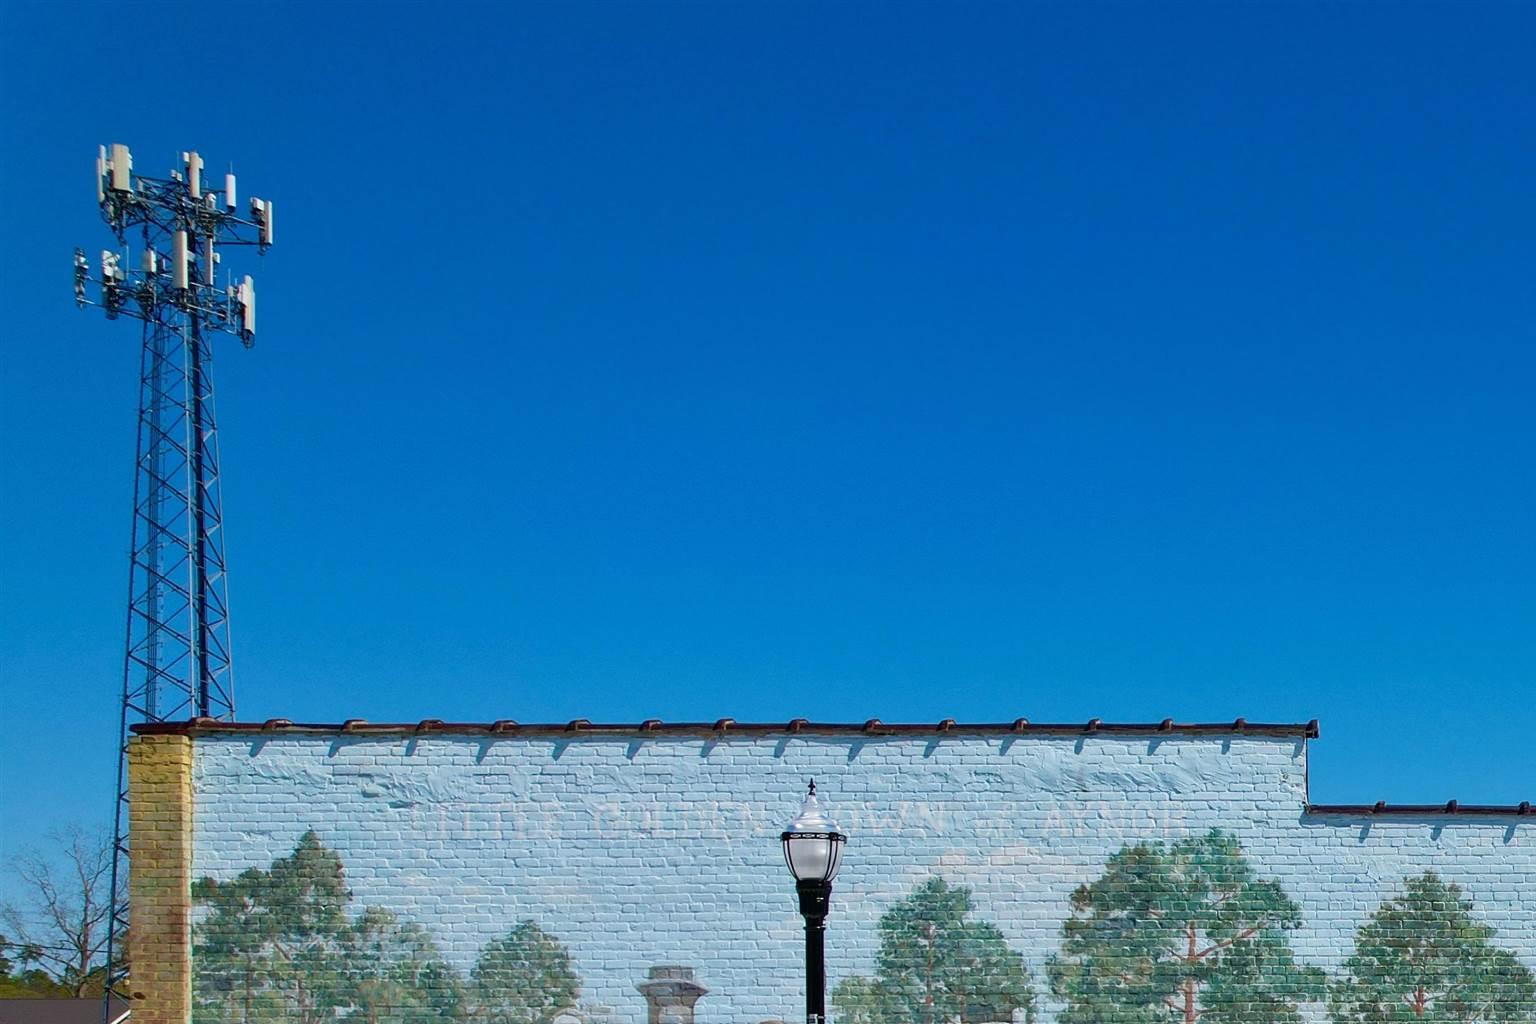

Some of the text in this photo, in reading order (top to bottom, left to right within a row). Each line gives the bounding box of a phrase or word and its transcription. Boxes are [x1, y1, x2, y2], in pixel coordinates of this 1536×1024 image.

[411, 801, 561, 840] LITTLE
[592, 800, 767, 838] GOLDEN
[832, 800, 946, 837] OWN
[1040, 800, 1190, 838] AYNOR
